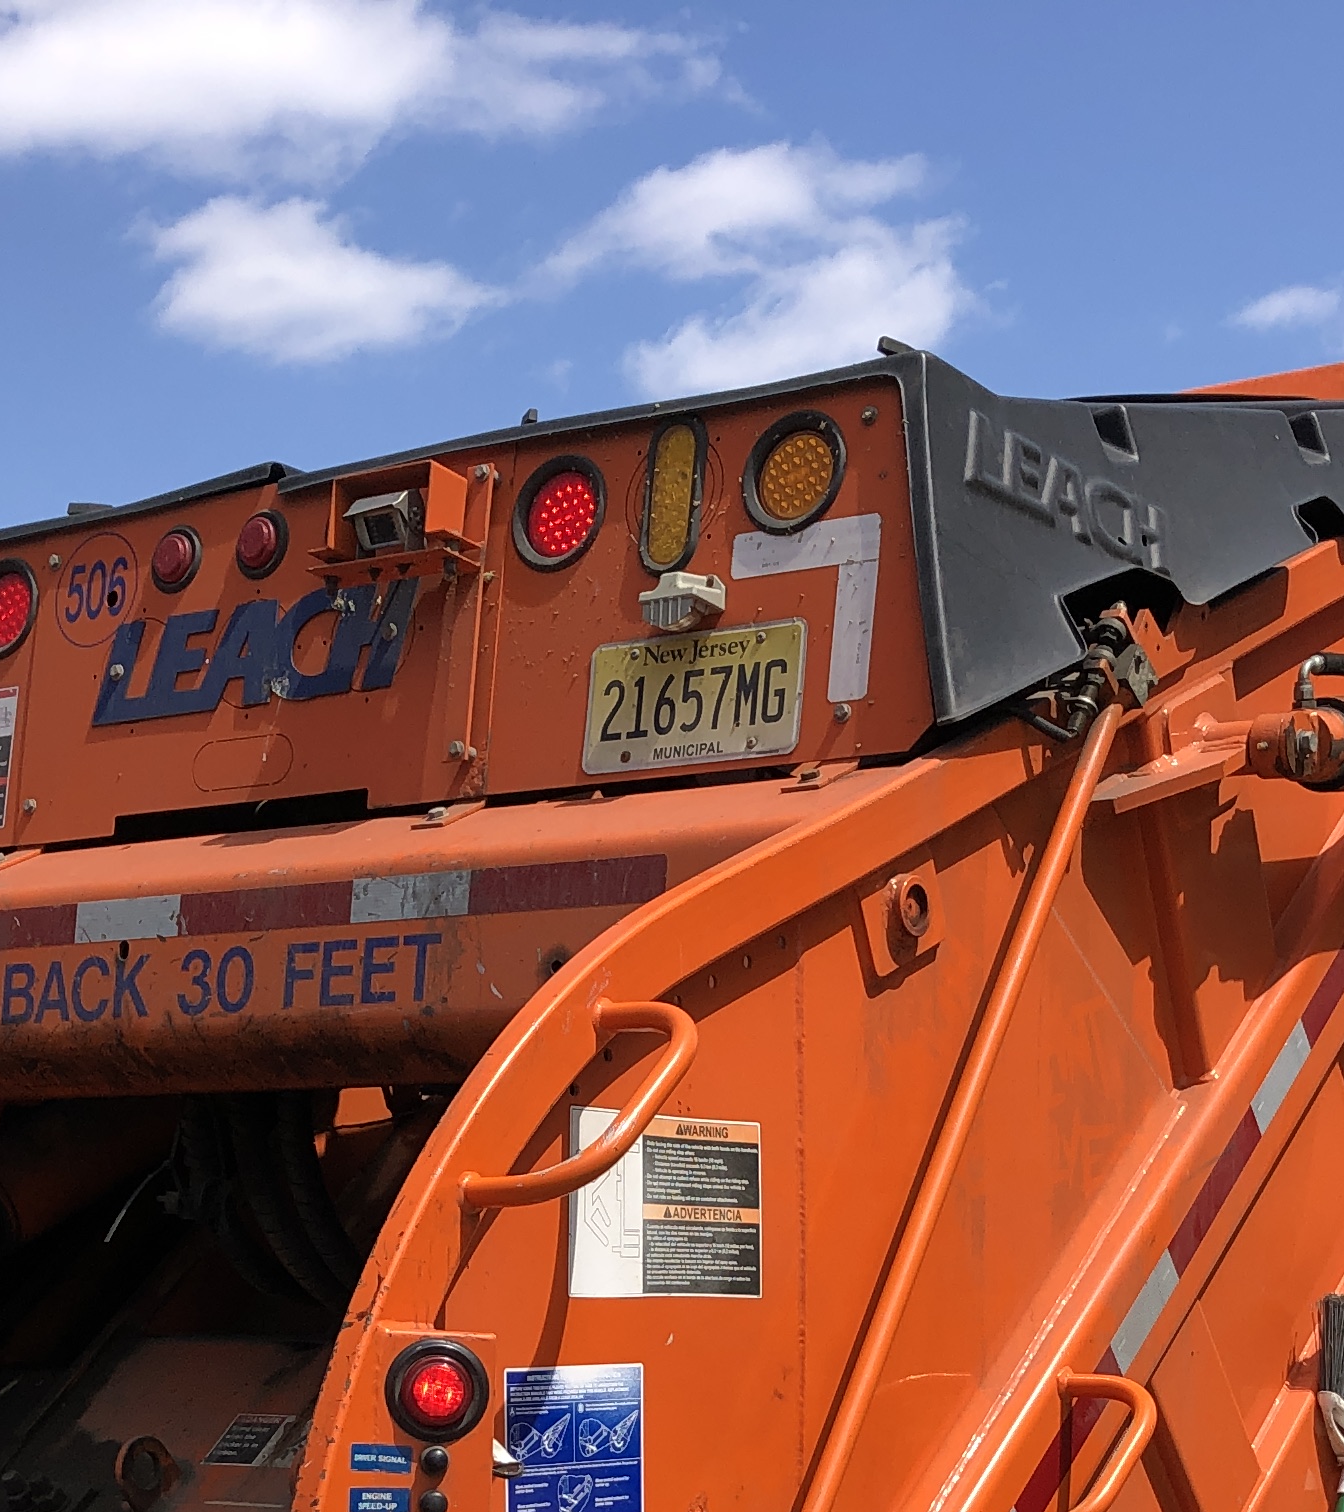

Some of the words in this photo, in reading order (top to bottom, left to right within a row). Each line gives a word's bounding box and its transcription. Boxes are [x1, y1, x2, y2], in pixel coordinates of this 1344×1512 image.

[964, 408, 1170, 577] LEACH
[65, 556, 129, 624] 506
[92, 577, 420, 727] LEACH
[643, 646, 685, 666] New
[689, 639, 751, 664] Jersey
[600, 659, 788, 742] 21657MG
[653, 741, 723, 760] MUNICIPAL
[1, 953, 151, 1026] BACK
[177, 945, 255, 1016] 30
[282, 933, 442, 1010] FEET
[683, 1124, 729, 1139] WARNING
[673, 1207, 742, 1222] ADVERTENCIA
[378, 1454, 407, 1464] SIGNAL
[357, 1502, 398, 1511] SPEED-UP
[362, 1492, 392, 1501] ENGINE
